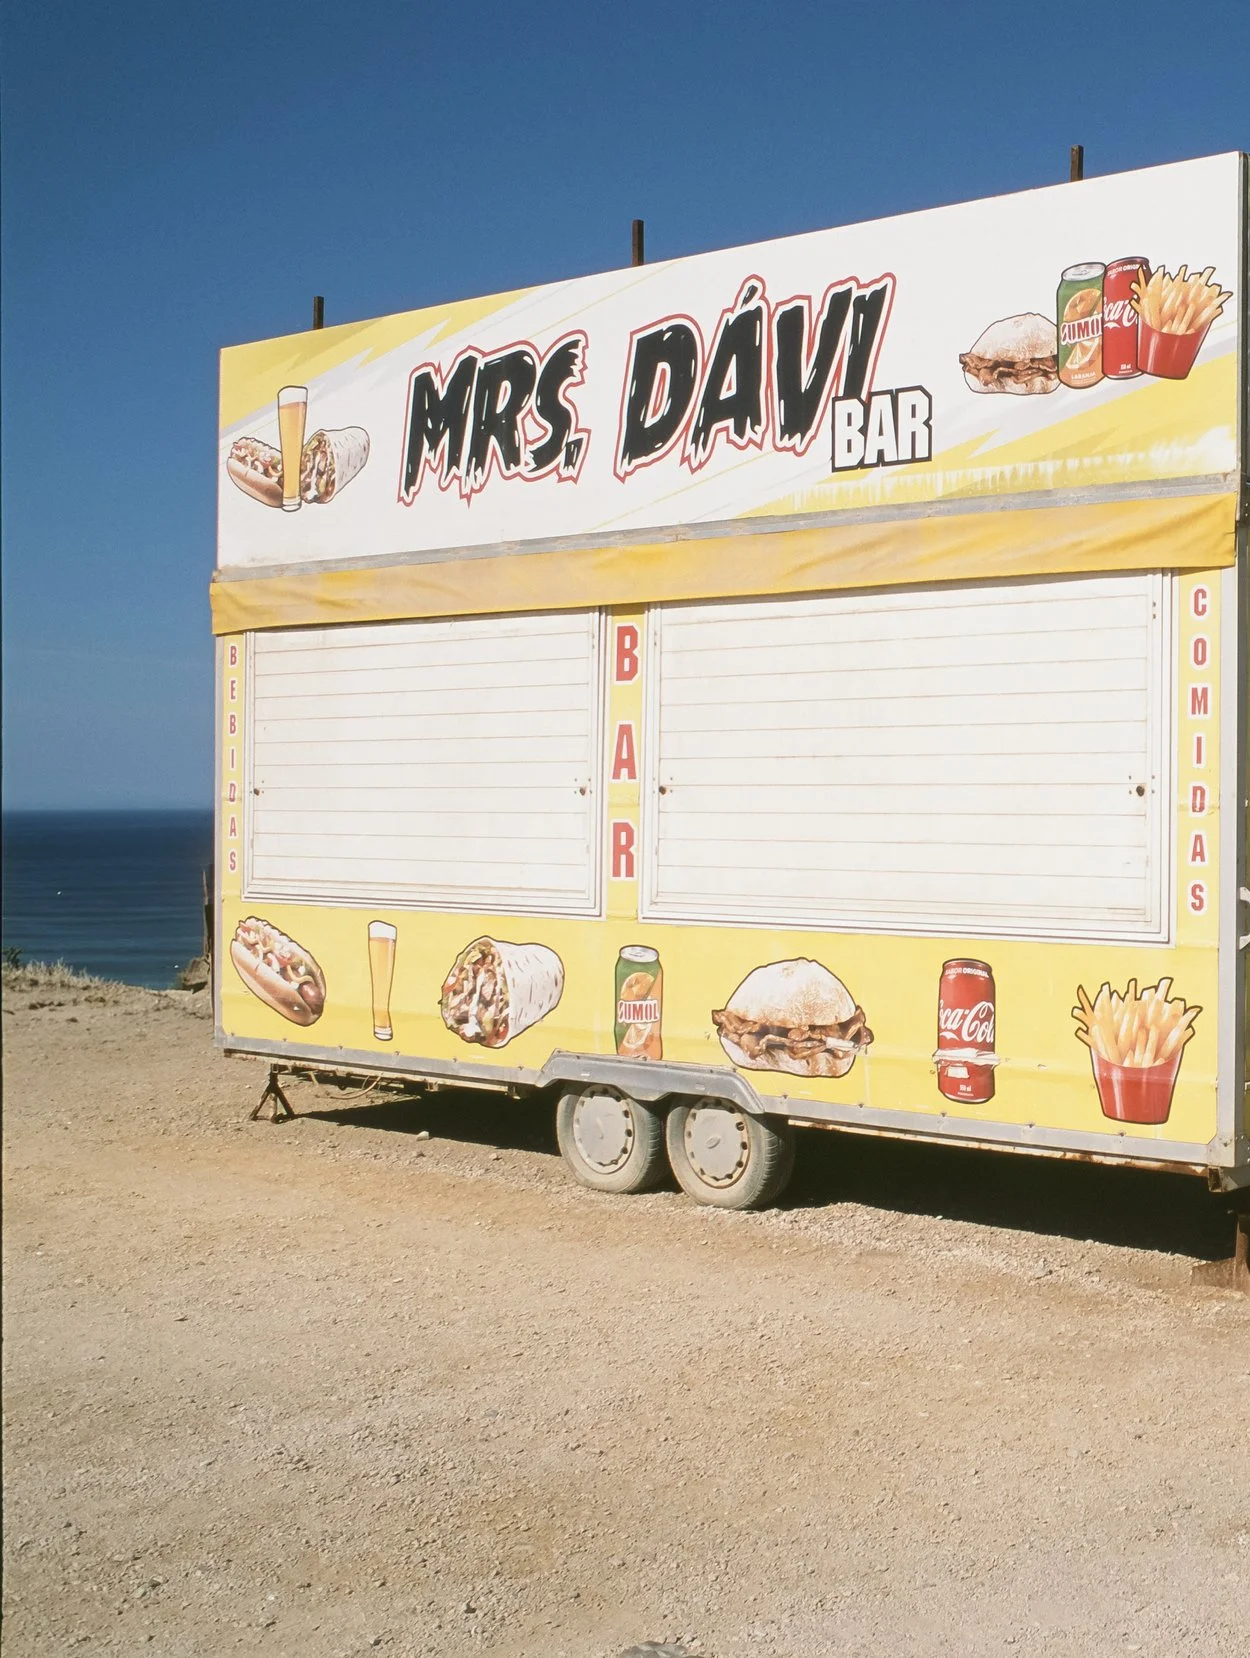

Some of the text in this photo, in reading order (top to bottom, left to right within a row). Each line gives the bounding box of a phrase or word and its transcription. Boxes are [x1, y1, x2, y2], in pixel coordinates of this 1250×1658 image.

[614, 274, 894, 480] DÁVI
[833, 386, 931, 471] BAR
[1061, 314, 1102, 345] SUMO
[228, 644, 238, 872] BEBIDAS
[611, 624, 639, 878] BAR
[1190, 587, 1209, 912] COMIDAS
